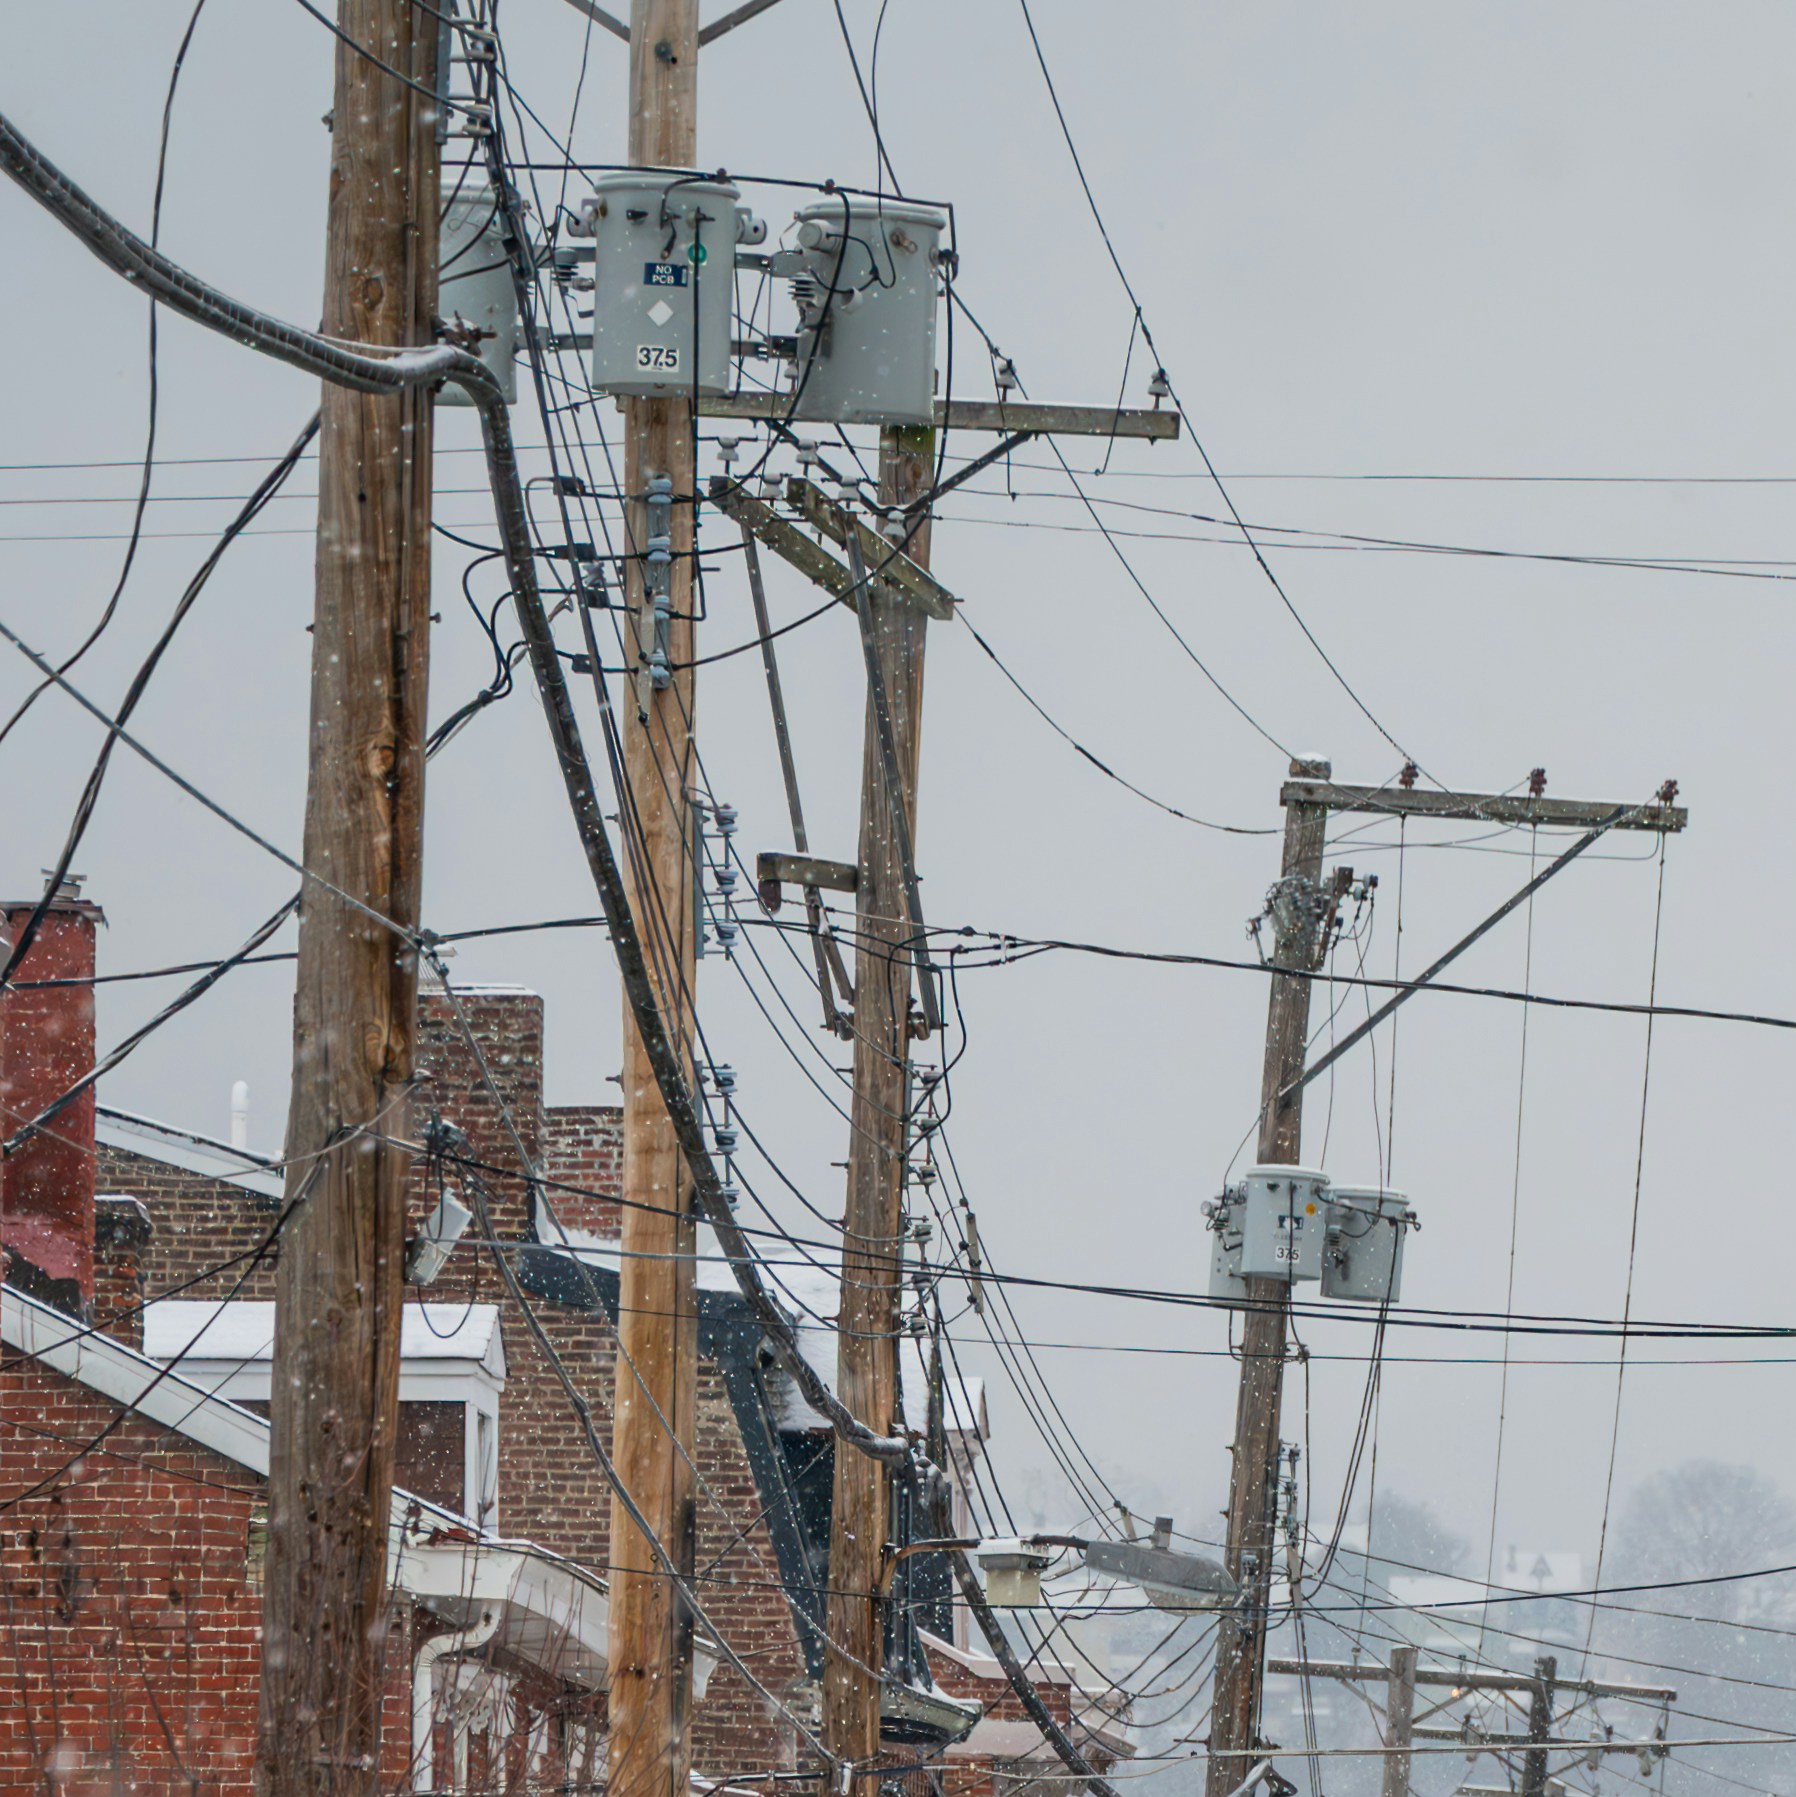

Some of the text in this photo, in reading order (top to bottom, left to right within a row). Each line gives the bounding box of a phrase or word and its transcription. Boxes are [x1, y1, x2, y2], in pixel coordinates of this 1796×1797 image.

[656, 265, 672, 274] NO
[652, 274, 675, 285] PCB
[639, 347, 678, 367] 37.5
